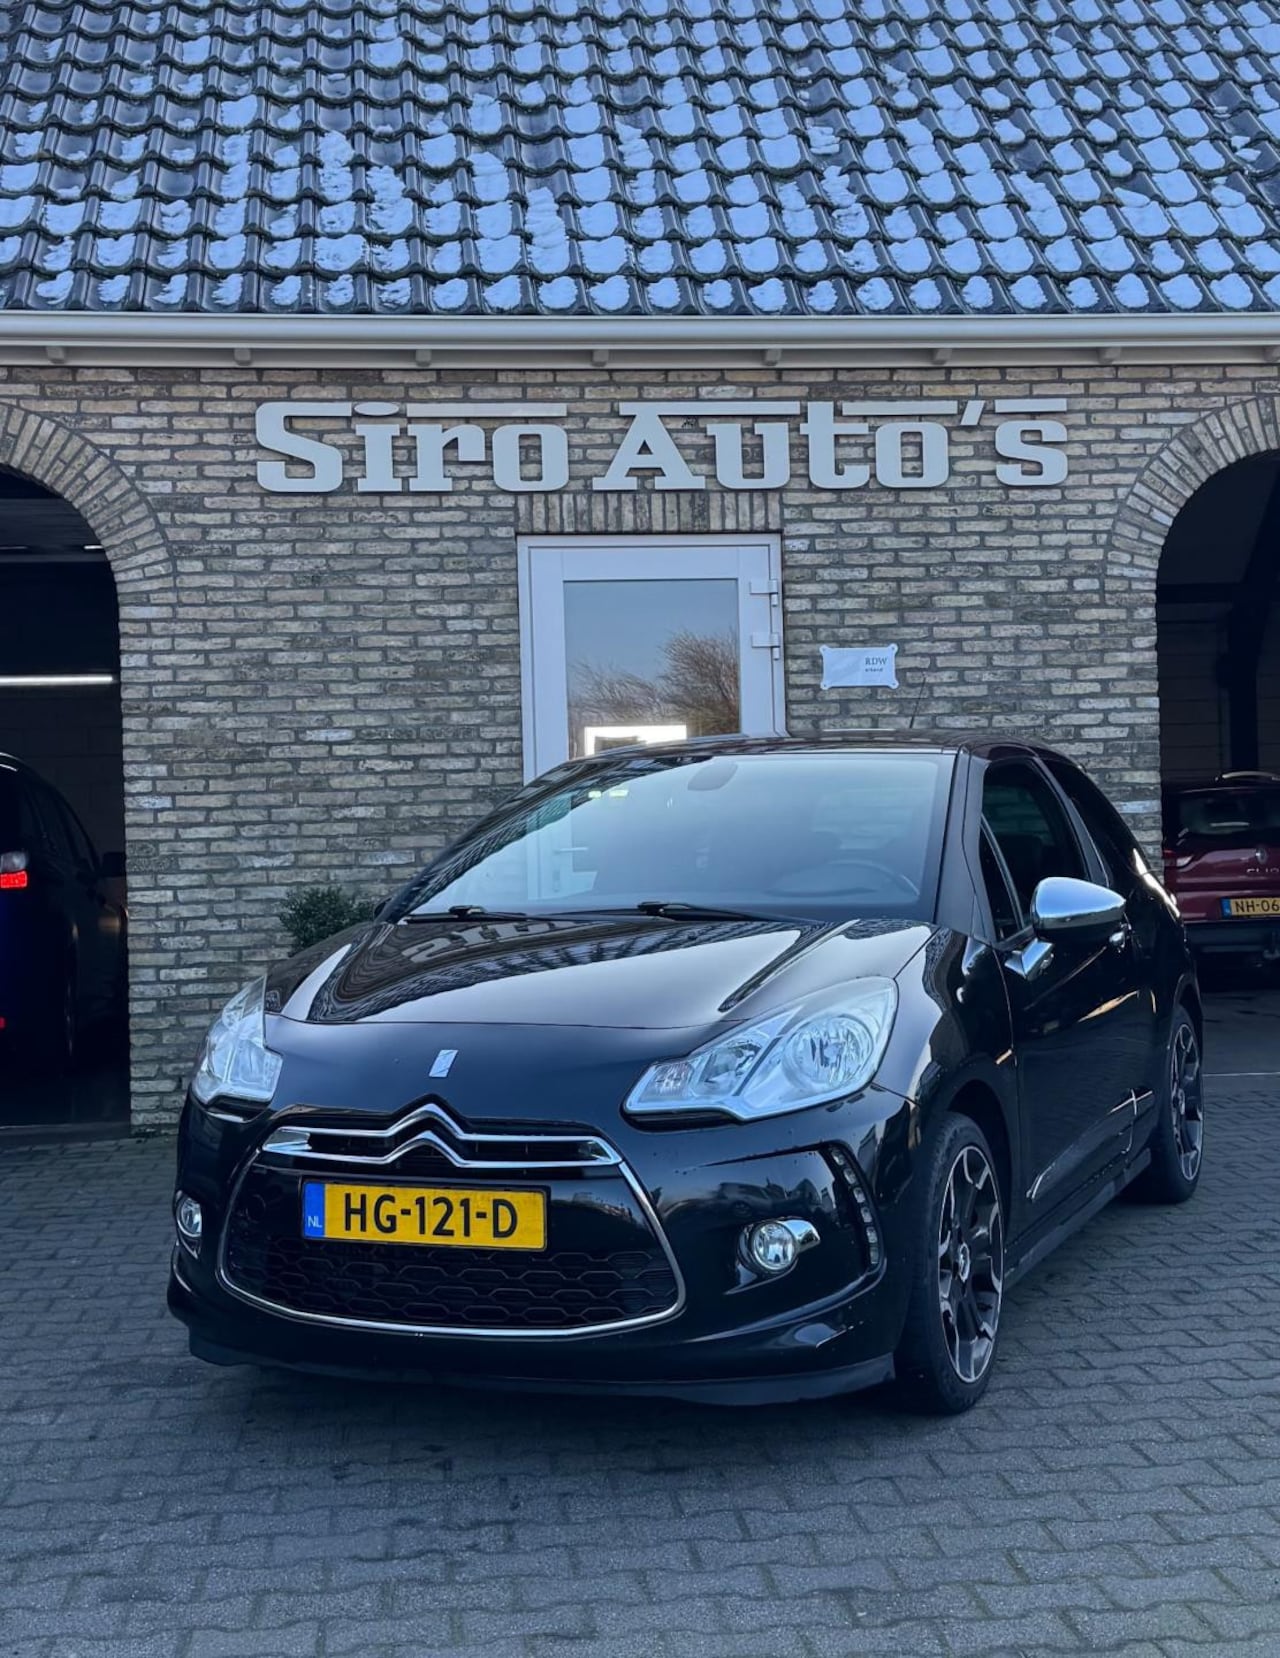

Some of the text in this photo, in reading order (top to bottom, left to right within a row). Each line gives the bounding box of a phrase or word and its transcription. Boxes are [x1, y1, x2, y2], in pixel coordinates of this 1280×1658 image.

[255, 398, 1068, 492] Siro Auto's
[865, 657, 887, 665] RDW
[307, 1192, 519, 1239] NL HG-121-D
